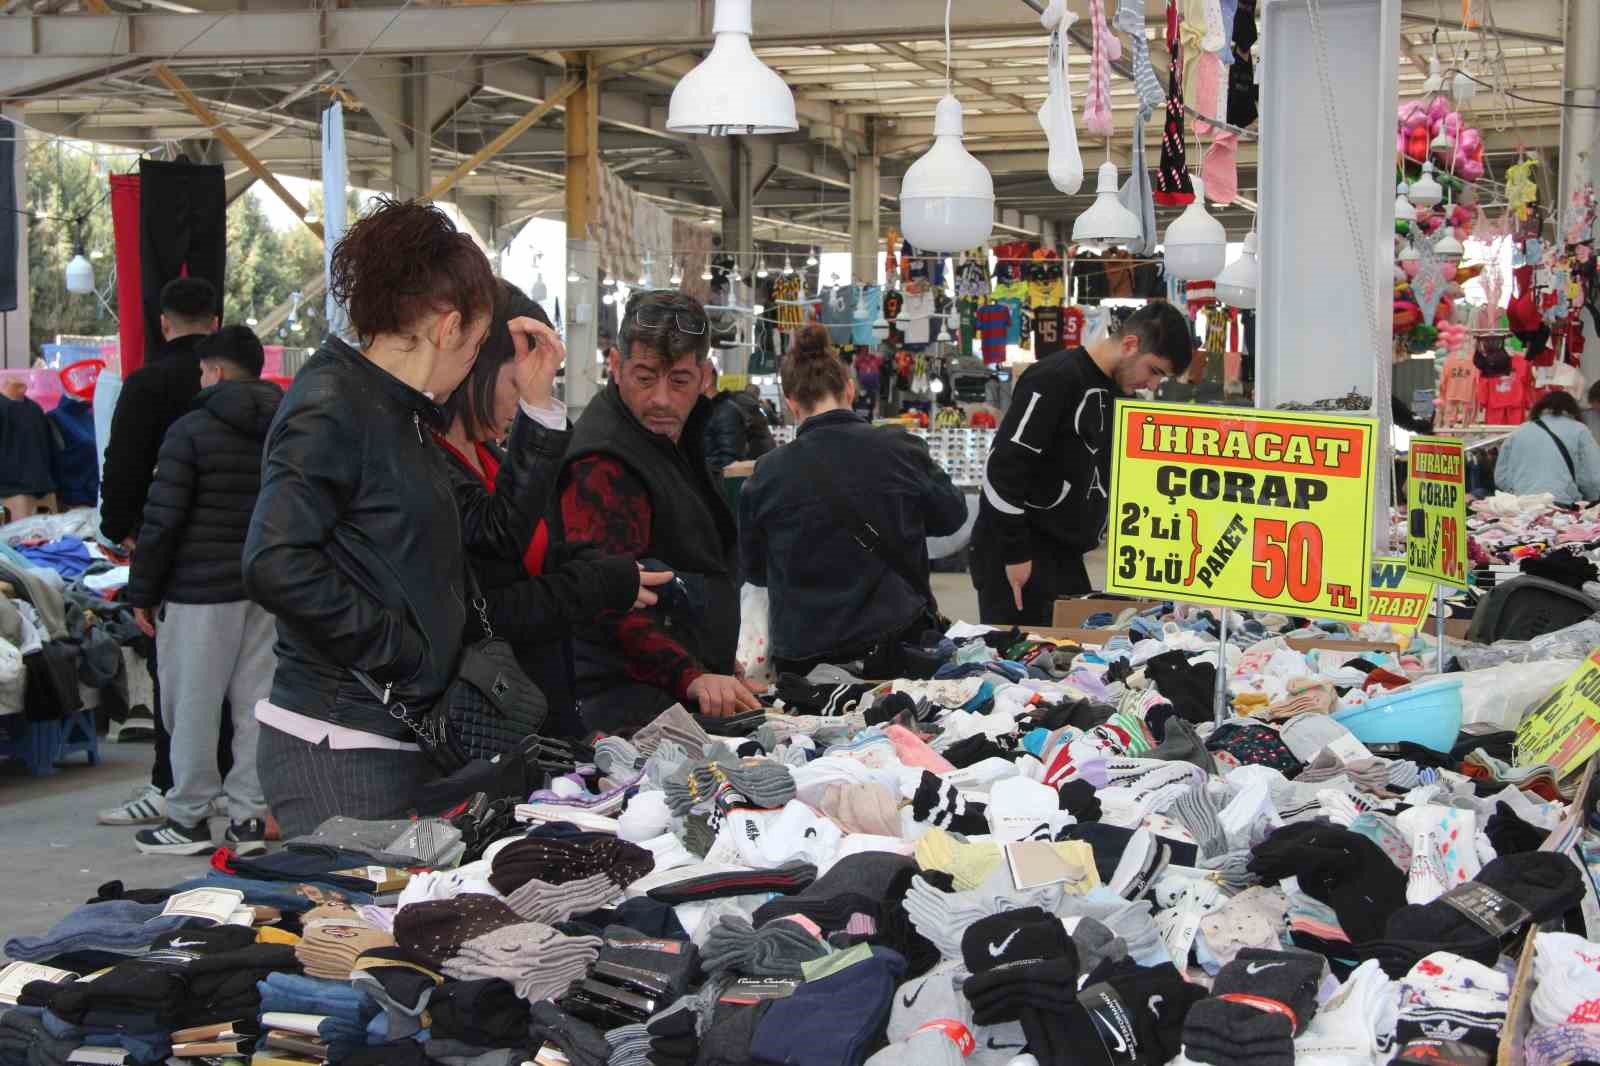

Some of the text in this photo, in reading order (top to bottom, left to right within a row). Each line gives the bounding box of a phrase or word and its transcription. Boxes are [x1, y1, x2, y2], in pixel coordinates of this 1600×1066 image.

[1141, 416, 1349, 468] İHRACAT
[1156, 465, 1328, 510] ÇORAP
[1121, 502, 1181, 541] 2'Lİ
[1118, 545, 1182, 585] 3'LÜ
[1196, 513, 1248, 589] PAKET
[1251, 518, 1357, 609] 50 TL
